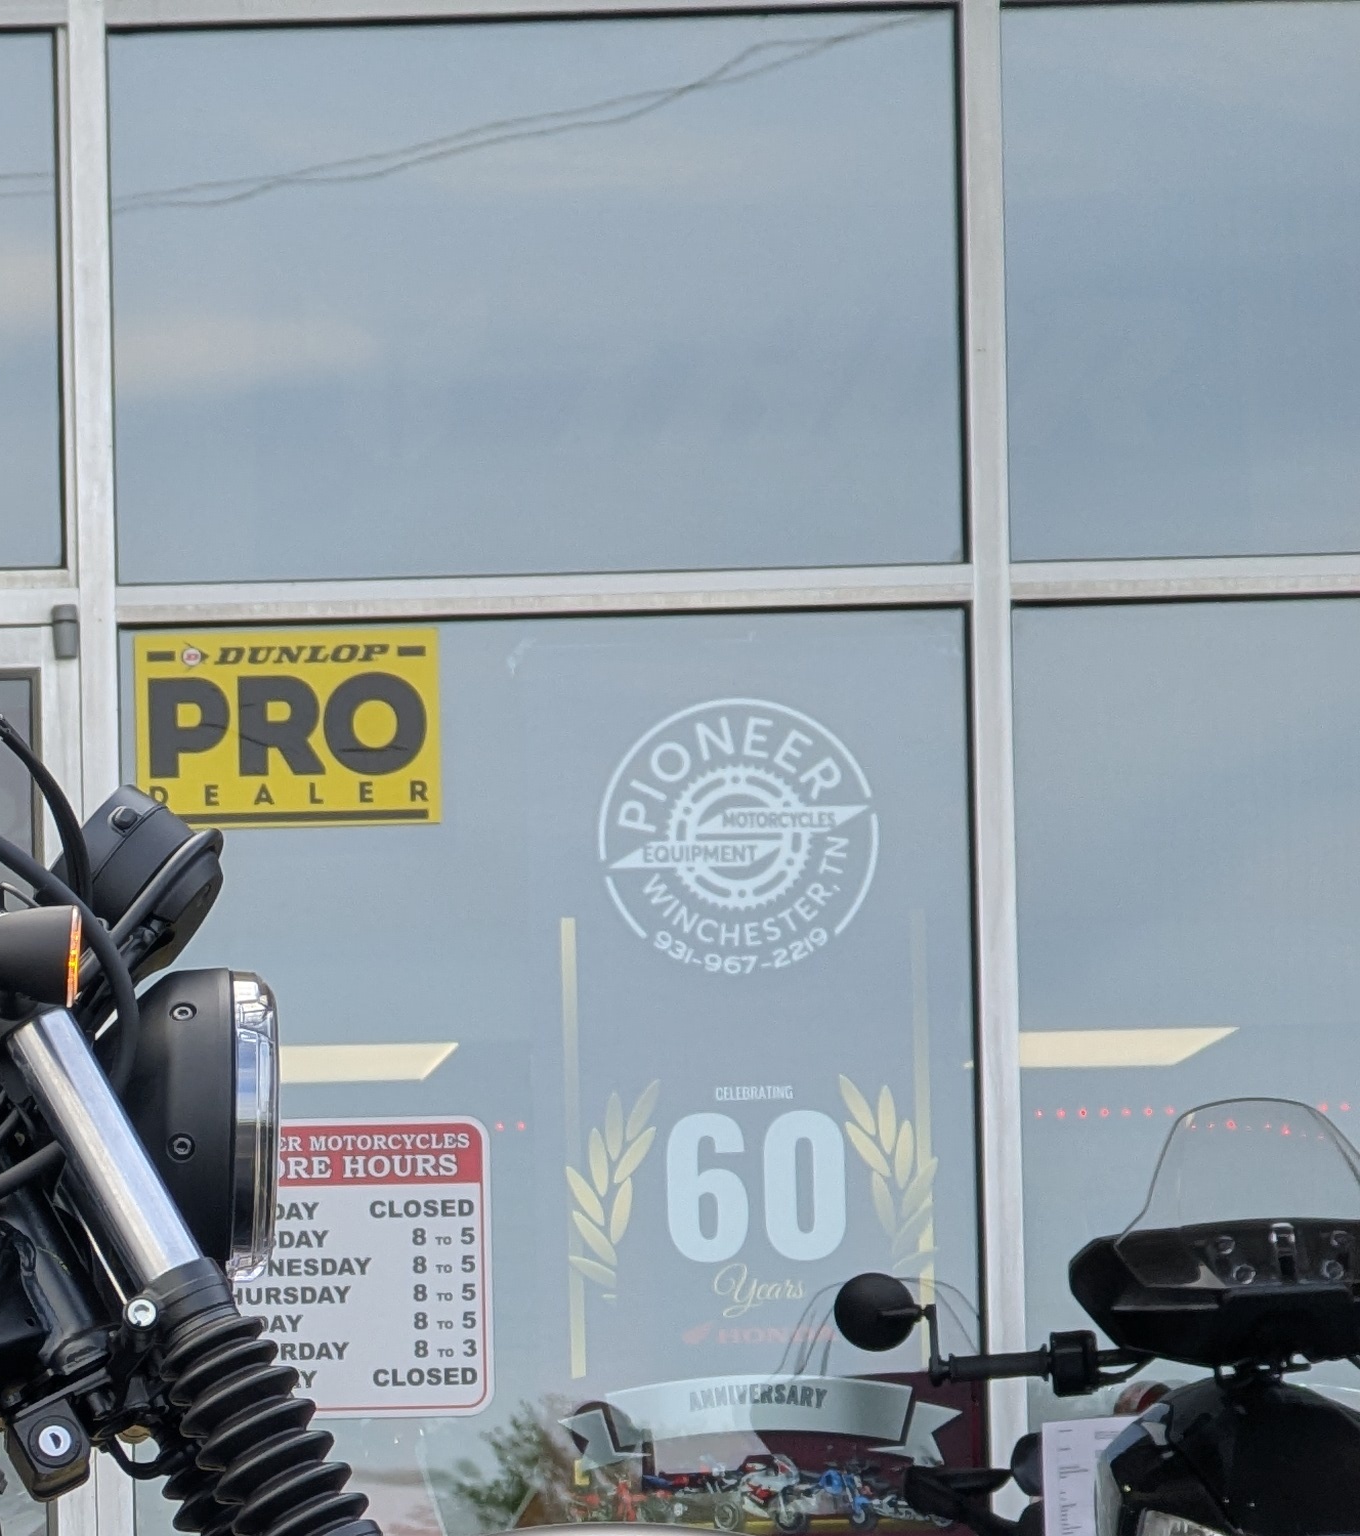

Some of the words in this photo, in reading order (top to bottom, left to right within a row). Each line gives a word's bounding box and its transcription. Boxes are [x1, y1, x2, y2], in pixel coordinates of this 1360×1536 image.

[214, 643, 390, 666] DUNLOP
[147, 671, 428, 779] PRO
[617, 716, 843, 832] PIONEER
[148, 780, 429, 806] DEALER
[722, 810, 837, 828] MOTORCYCLES
[642, 844, 758, 863] EQUIPMENT
[642, 873, 841, 946] WINCHESTER,
[819, 836, 850, 875] TN
[654, 927, 829, 975] 931-967-2219
[715, 1085, 794, 1101] CELEBRATING
[310, 1133, 470, 1151] MOTORCYCLES
[343, 1154, 458, 1178] HOURS
[666, 1110, 847, 1263] 60
[369, 1199, 475, 1218] CLOSED
[412, 1228, 427, 1245] 8
[435, 1236, 452, 1245] TO
[460, 1227, 475, 1245] 5
[267, 1257, 372, 1277] NESDAY
[412, 1256, 427, 1274] 8
[435, 1264, 453, 1274] TO
[461, 1255, 475, 1273] 5
[233, 1285, 351, 1305] HURSDAY
[413, 1284, 428, 1302] 8
[436, 1292, 453, 1302] TO
[461, 1283, 476, 1301] 5
[713, 1263, 807, 1318] Years
[413, 1312, 428, 1330] 8
[437, 1320, 454, 1330] TO
[462, 1311, 476, 1329] 5
[280, 1342, 350, 1361] RDAY
[414, 1340, 429, 1358] 8
[437, 1349, 454, 1358] TO
[462, 1339, 477, 1357] 3
[372, 1367, 478, 1387] CLOSED
[688, 1383, 828, 1412] ANNIVERSARY
